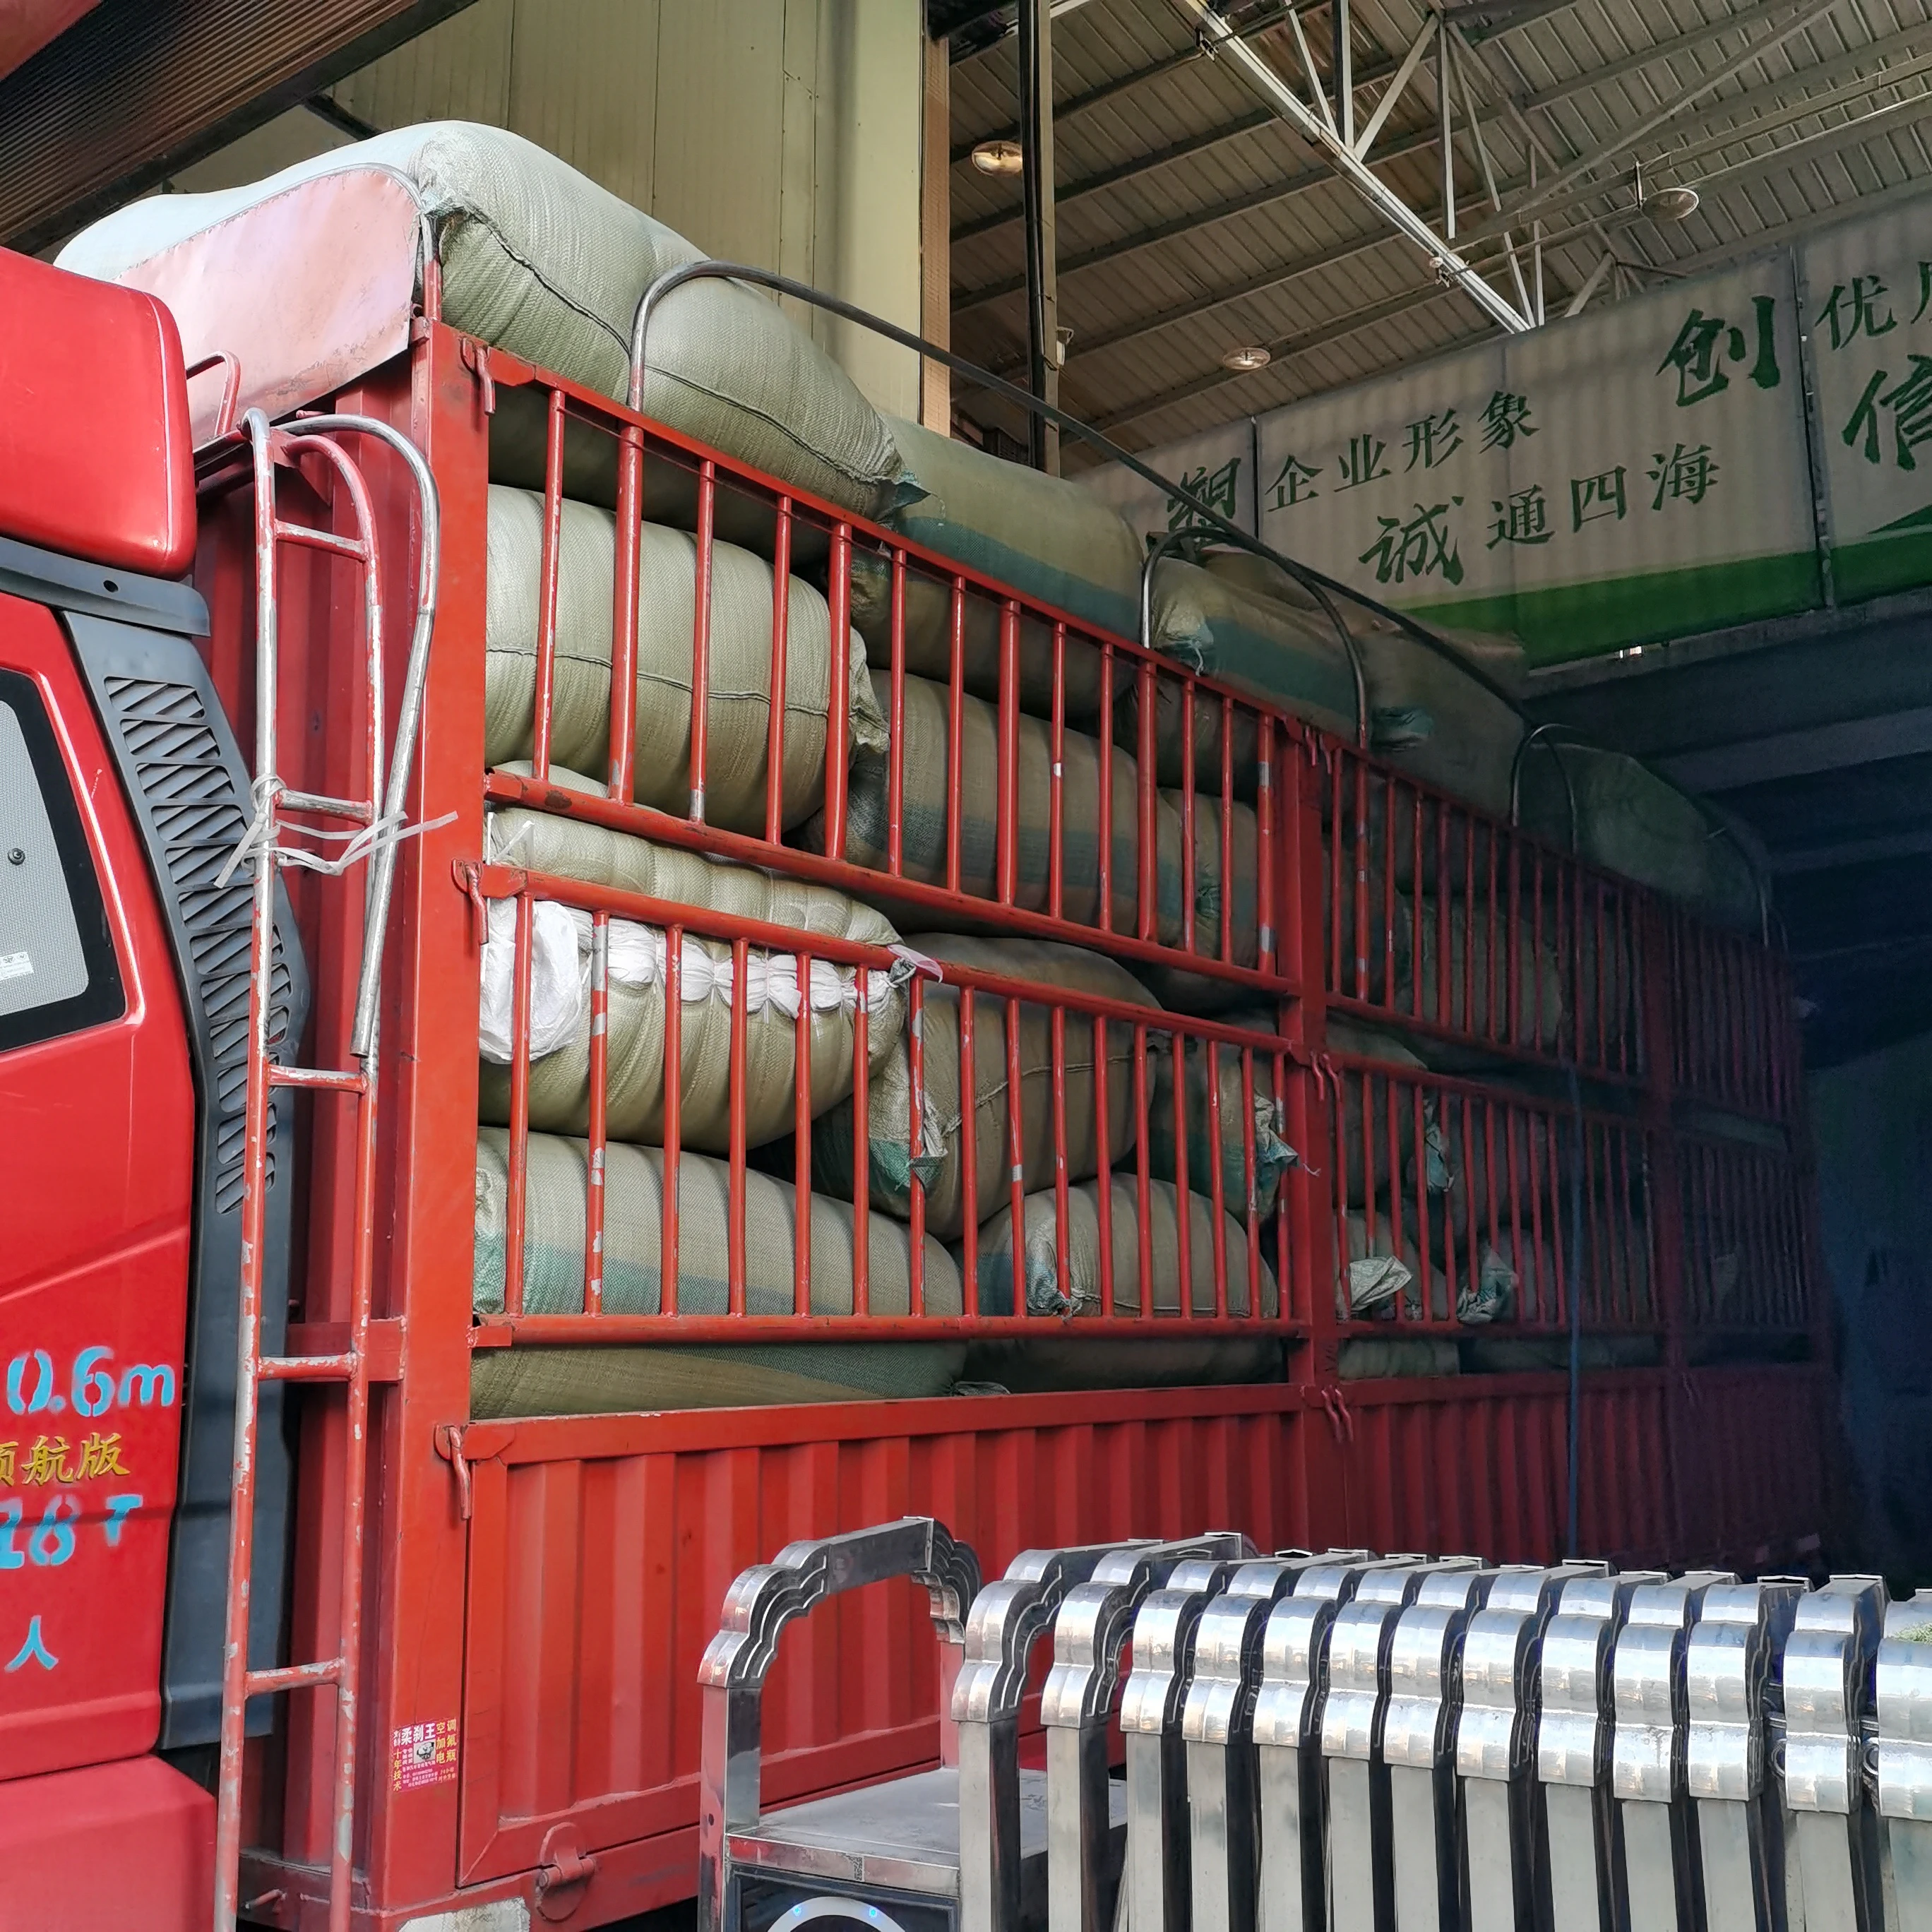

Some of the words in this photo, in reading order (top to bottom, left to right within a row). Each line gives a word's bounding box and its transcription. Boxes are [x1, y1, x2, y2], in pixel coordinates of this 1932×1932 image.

[1656, 260, 1932, 407] 创优
[1358, 442, 1721, 586] 诚通四海
[6, 1345, 177, 1417] 0.6m
[4, 1615, 60, 1672] 人
[401, 1723, 436, 1746] 柔刹王
[436, 1719, 457, 1735] 空调
[393, 1748, 402, 1791] 十年技术
[436, 1749, 457, 1764] 电瓶
